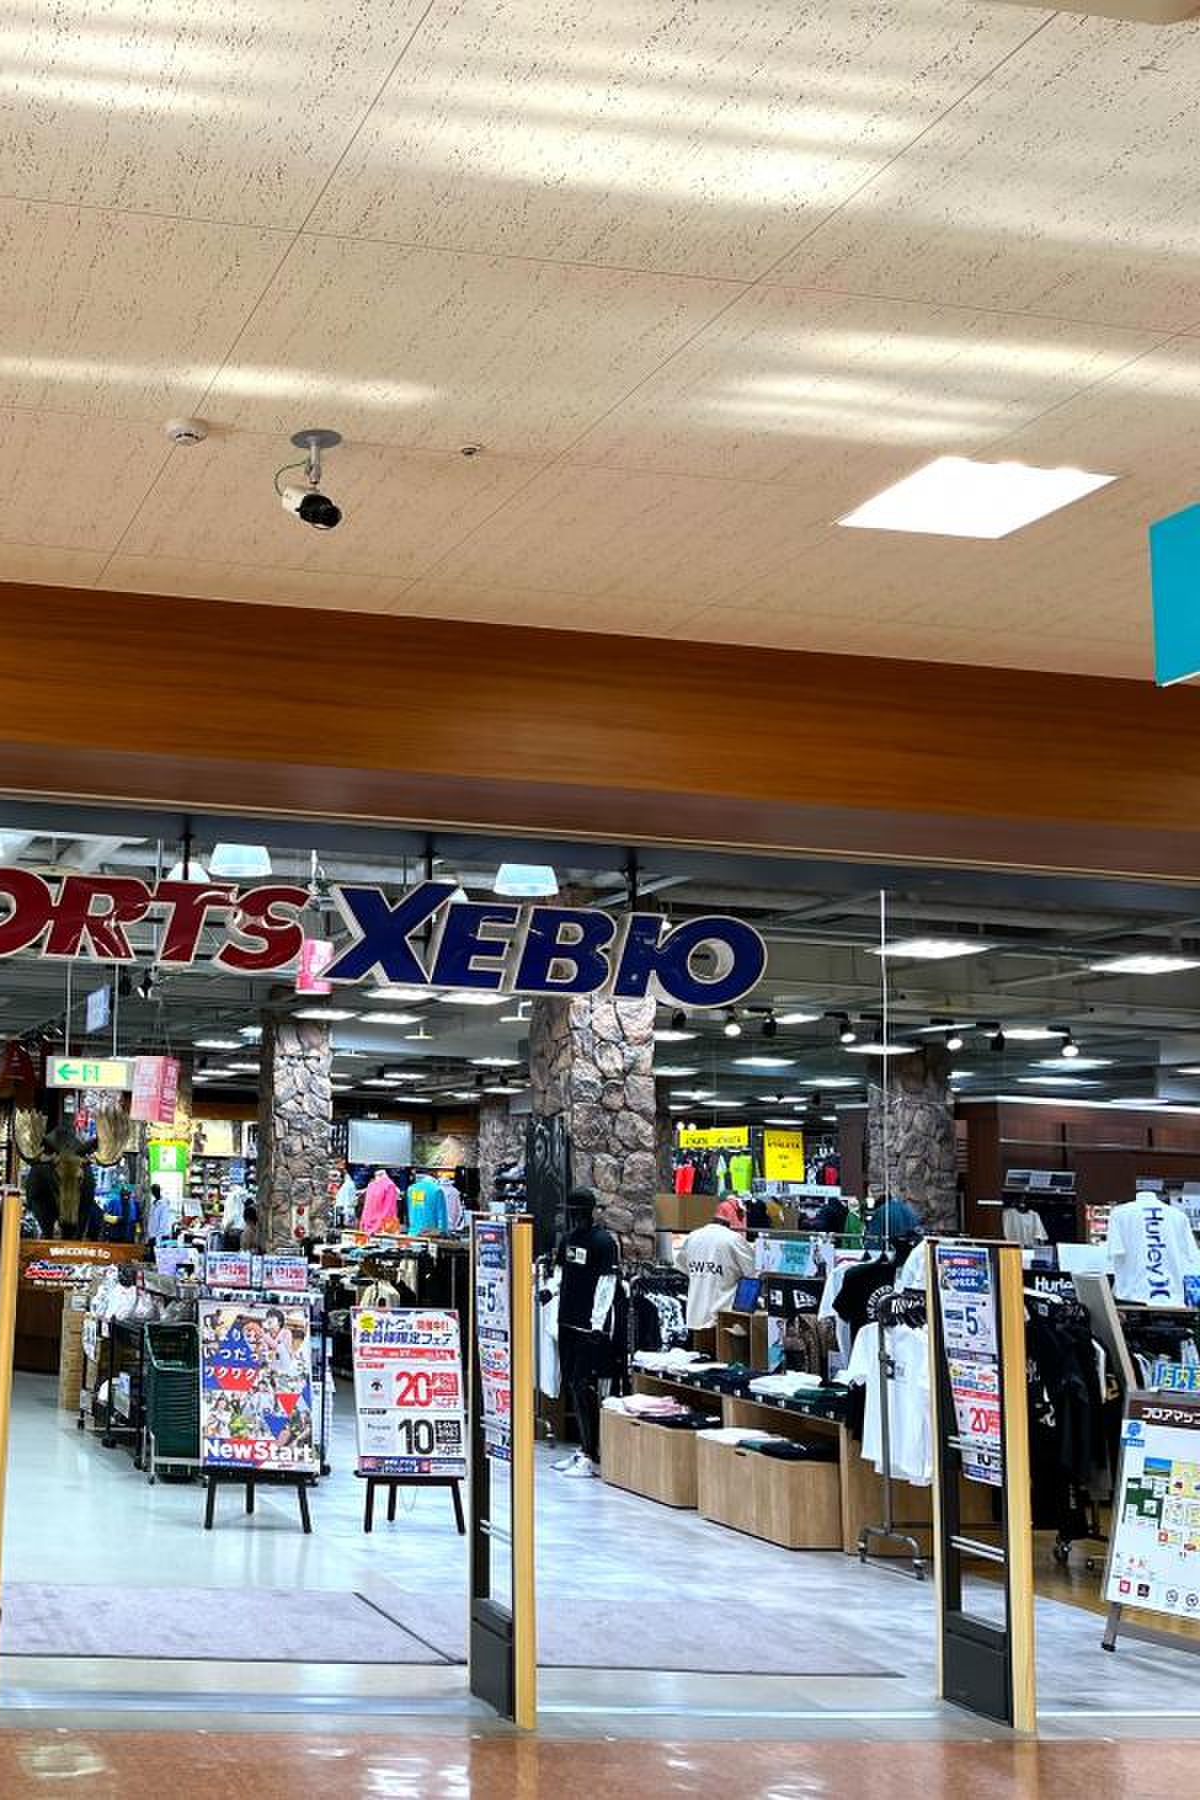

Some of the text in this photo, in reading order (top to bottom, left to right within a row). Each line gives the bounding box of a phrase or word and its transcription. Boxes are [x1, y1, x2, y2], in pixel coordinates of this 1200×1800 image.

[316, 880, 768, 1008] XEBIO
[1142, 1207, 1166, 1275] Hurley
[1035, 1276, 1073, 1293] Hurle
[966, 1306, 978, 1336] 5
[395, 1371, 432, 1407] 20
[398, 1418, 434, 1455] 10
[969, 1407, 989, 1434] 20
